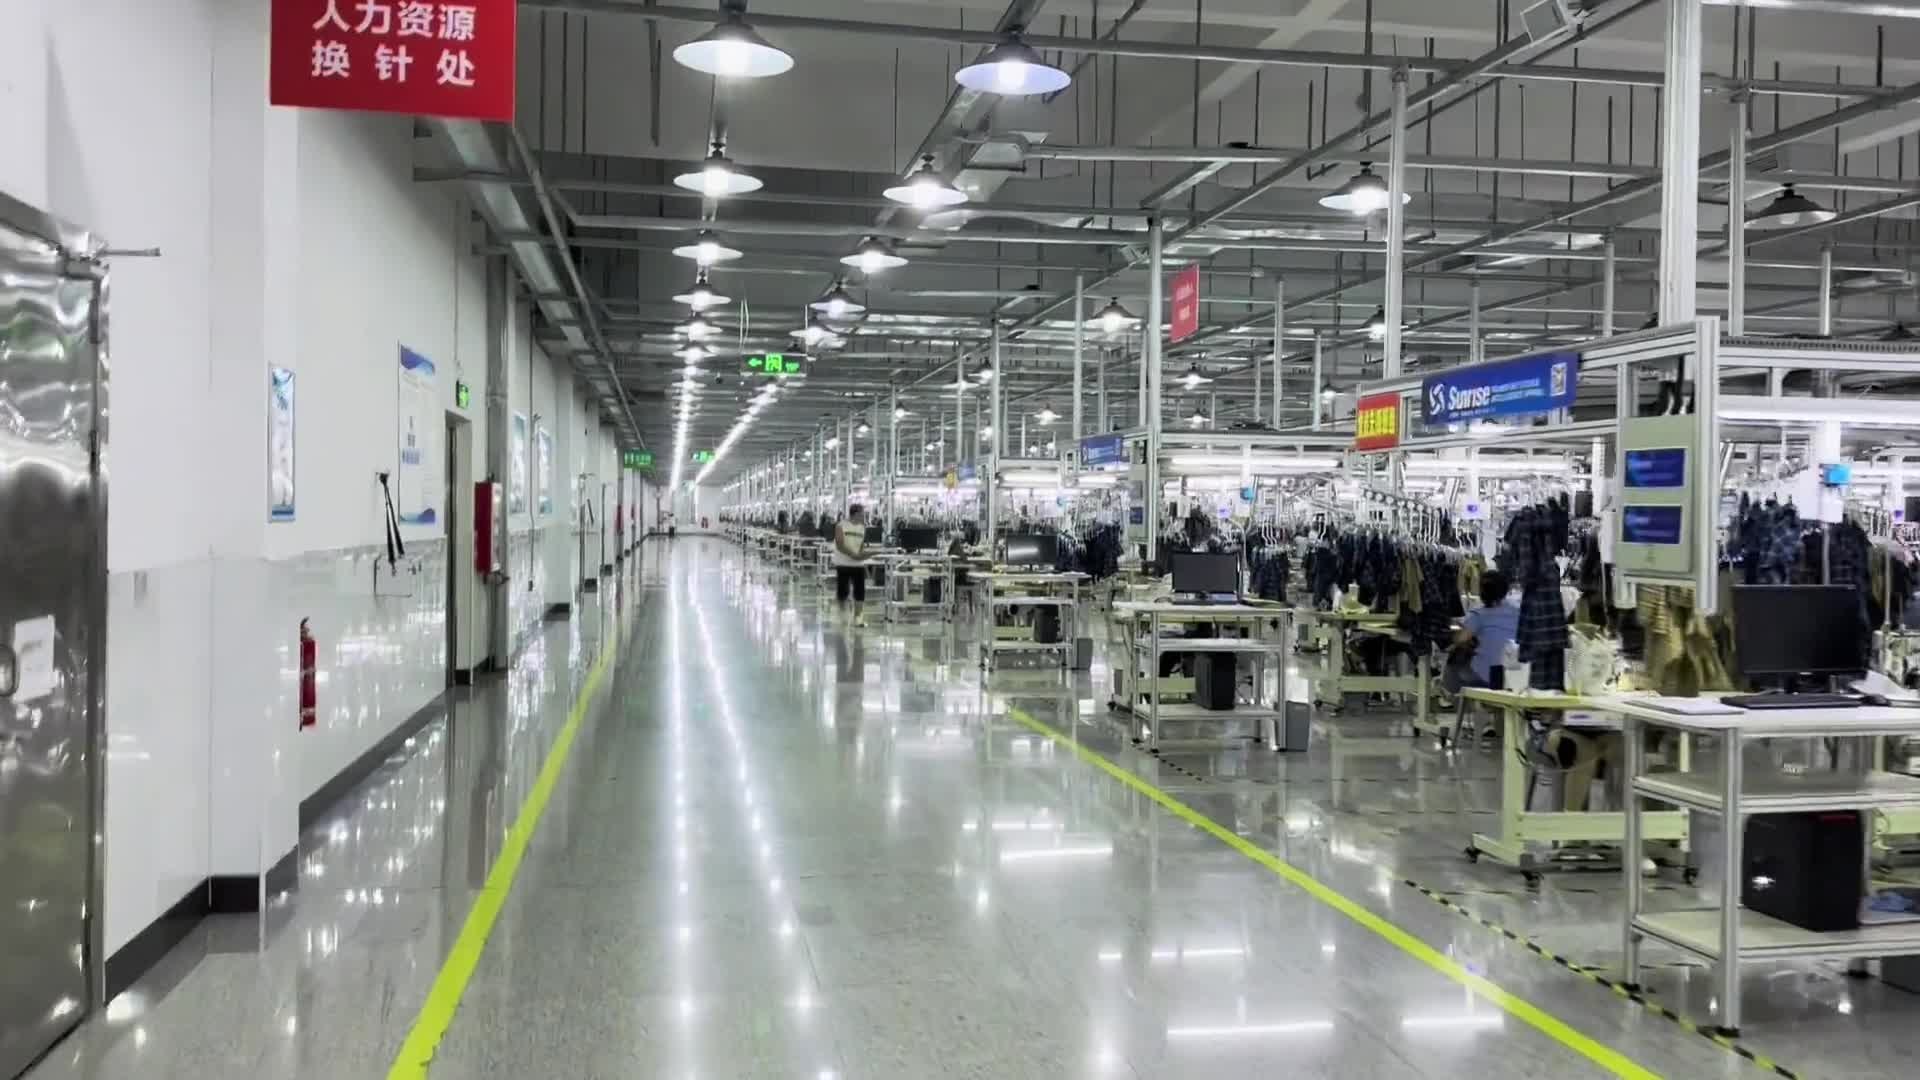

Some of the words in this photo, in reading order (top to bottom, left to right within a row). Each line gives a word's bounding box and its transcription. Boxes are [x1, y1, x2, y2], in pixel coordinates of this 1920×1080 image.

[312, 0, 476, 41] 人力资源
[311, 39, 476, 87] 换针处
[1448, 385, 1491, 411] Sunrise
